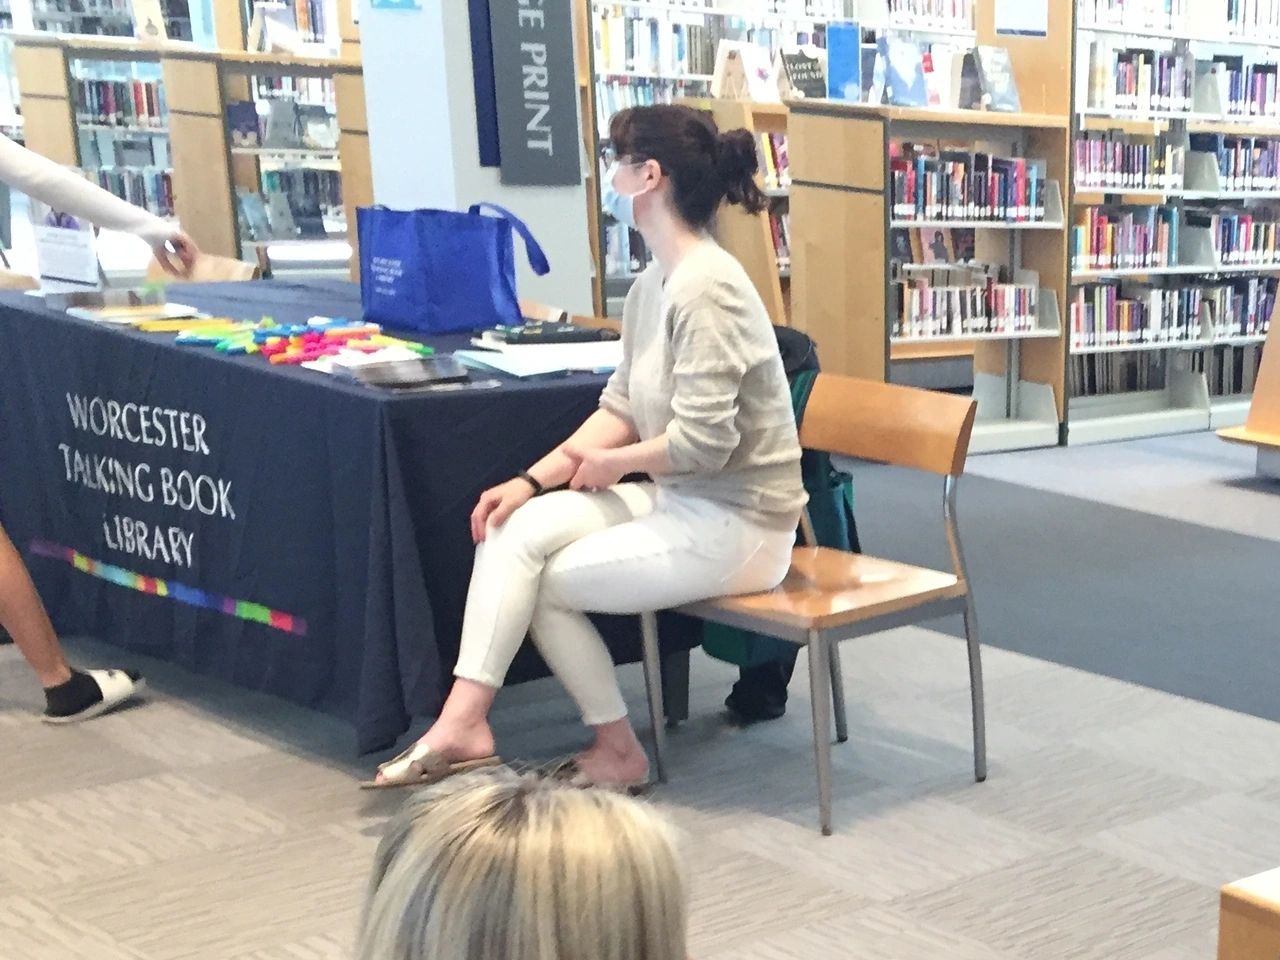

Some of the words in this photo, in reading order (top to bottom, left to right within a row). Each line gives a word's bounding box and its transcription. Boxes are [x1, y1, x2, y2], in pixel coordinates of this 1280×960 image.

[518, 0, 544, 29] E
[521, 42, 553, 156] PRINT
[66, 392, 209, 455] WORCESTER
[58, 443, 154, 502] TALKING
[160, 466, 236, 520] BOOK
[102, 514, 194, 568] LIBRARY
